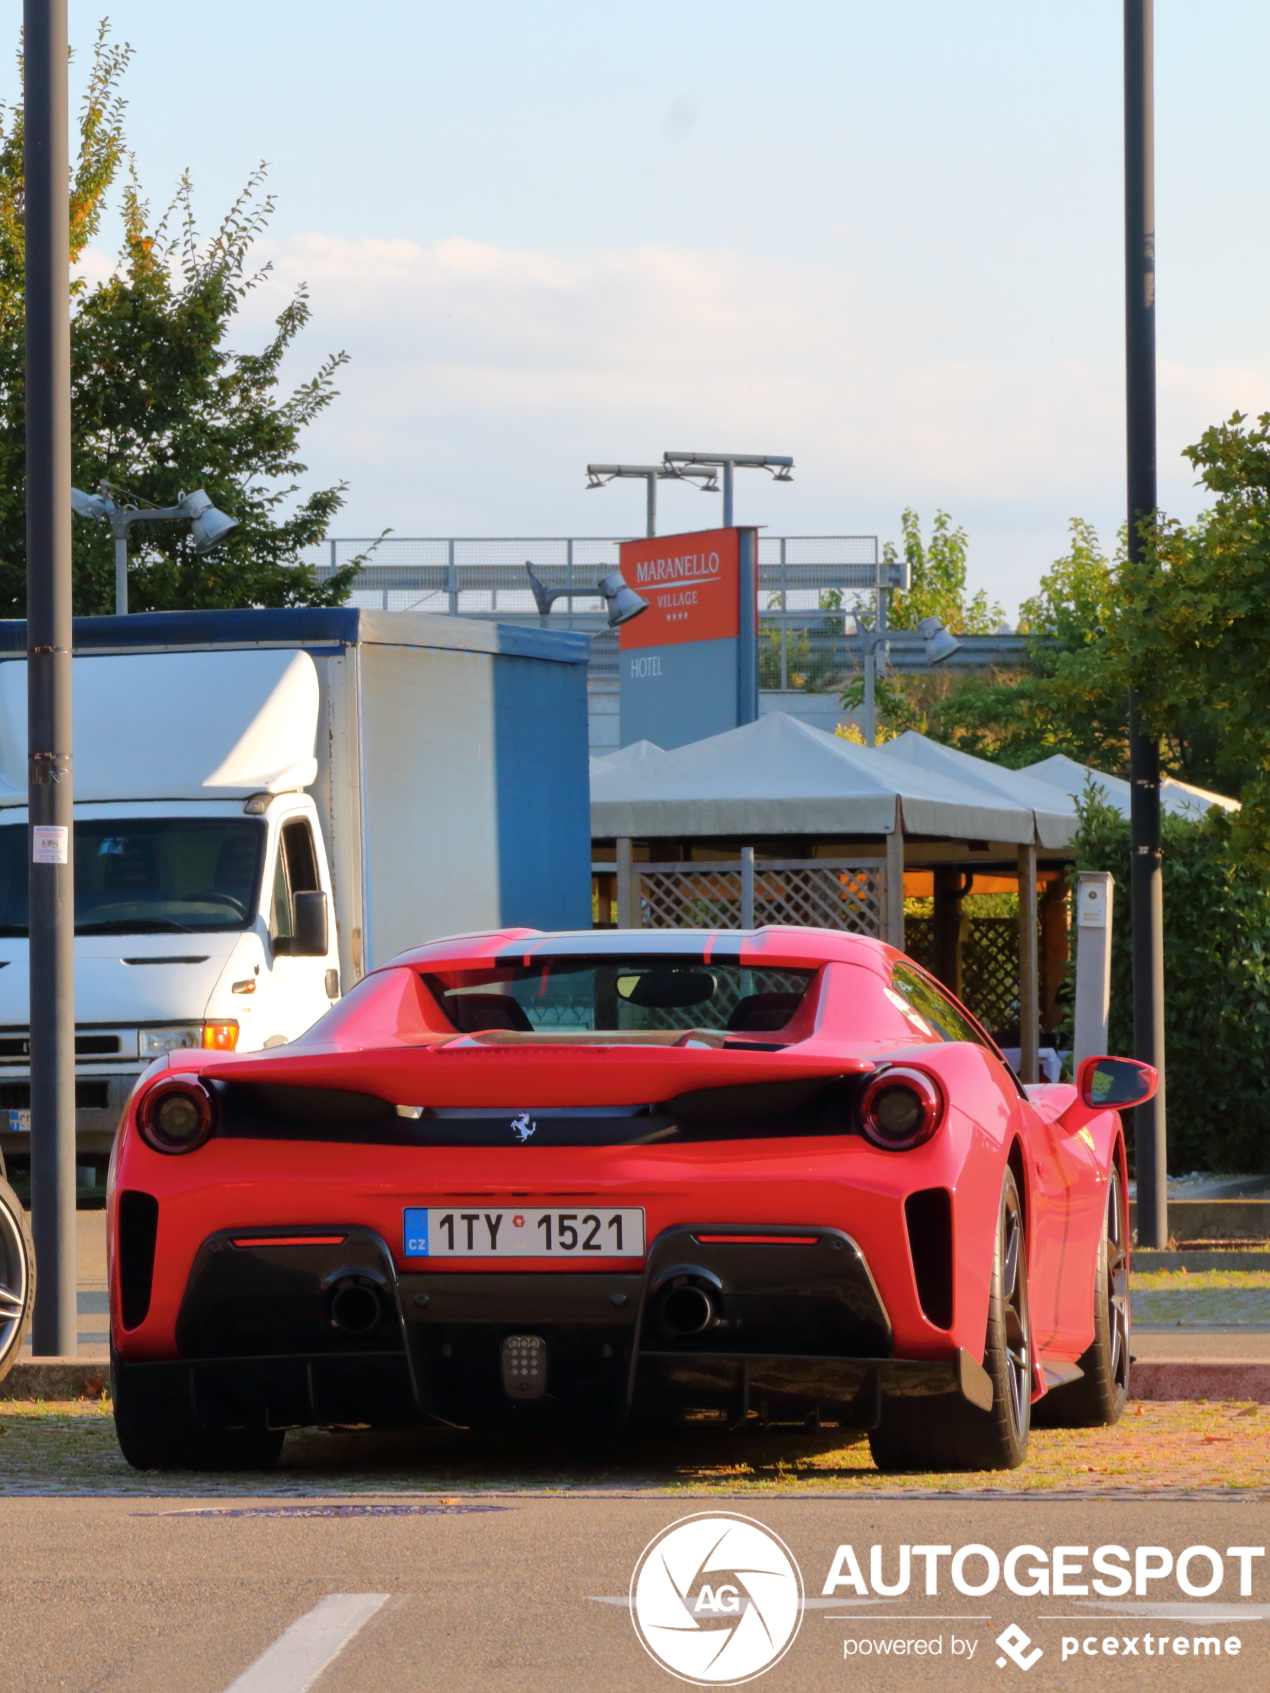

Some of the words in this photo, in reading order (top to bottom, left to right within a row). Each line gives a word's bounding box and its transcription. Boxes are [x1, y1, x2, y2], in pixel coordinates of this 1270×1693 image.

[636, 552, 720, 583] MARANELLO
[657, 591, 698, 608] VILLAGE
[631, 656, 662, 678] HOTEL
[439, 1214, 503, 1250] 1TY
[537, 1214, 623, 1250] 1521
[408, 1239, 426, 1250] CZ
